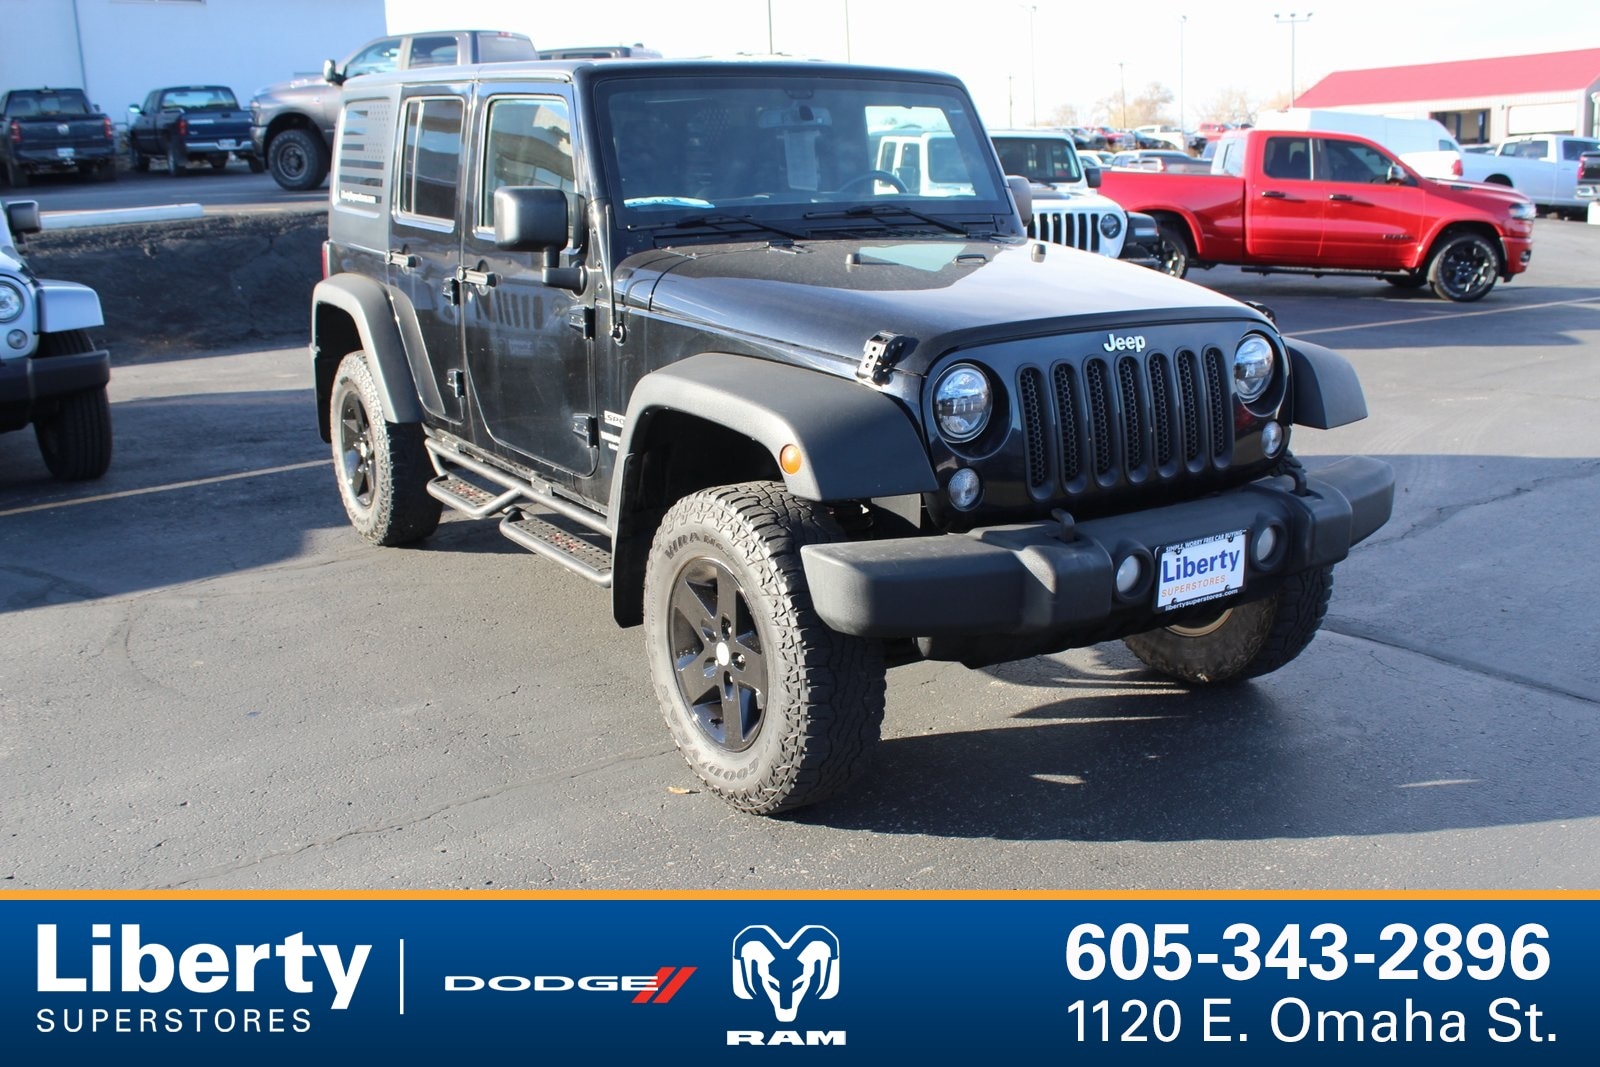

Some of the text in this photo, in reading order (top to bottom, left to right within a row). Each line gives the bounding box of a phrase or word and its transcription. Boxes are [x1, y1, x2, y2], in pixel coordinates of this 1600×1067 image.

[1103, 333, 1146, 353] Jeep
[1185, 539, 1203, 549] WORRY
[1215, 533, 1224, 541] CAR
[1162, 549, 1240, 584] Liberty
[1161, 575, 1226, 598] SUPERSTORES
[1165, 589, 1238, 611] libertysuperstores.com
